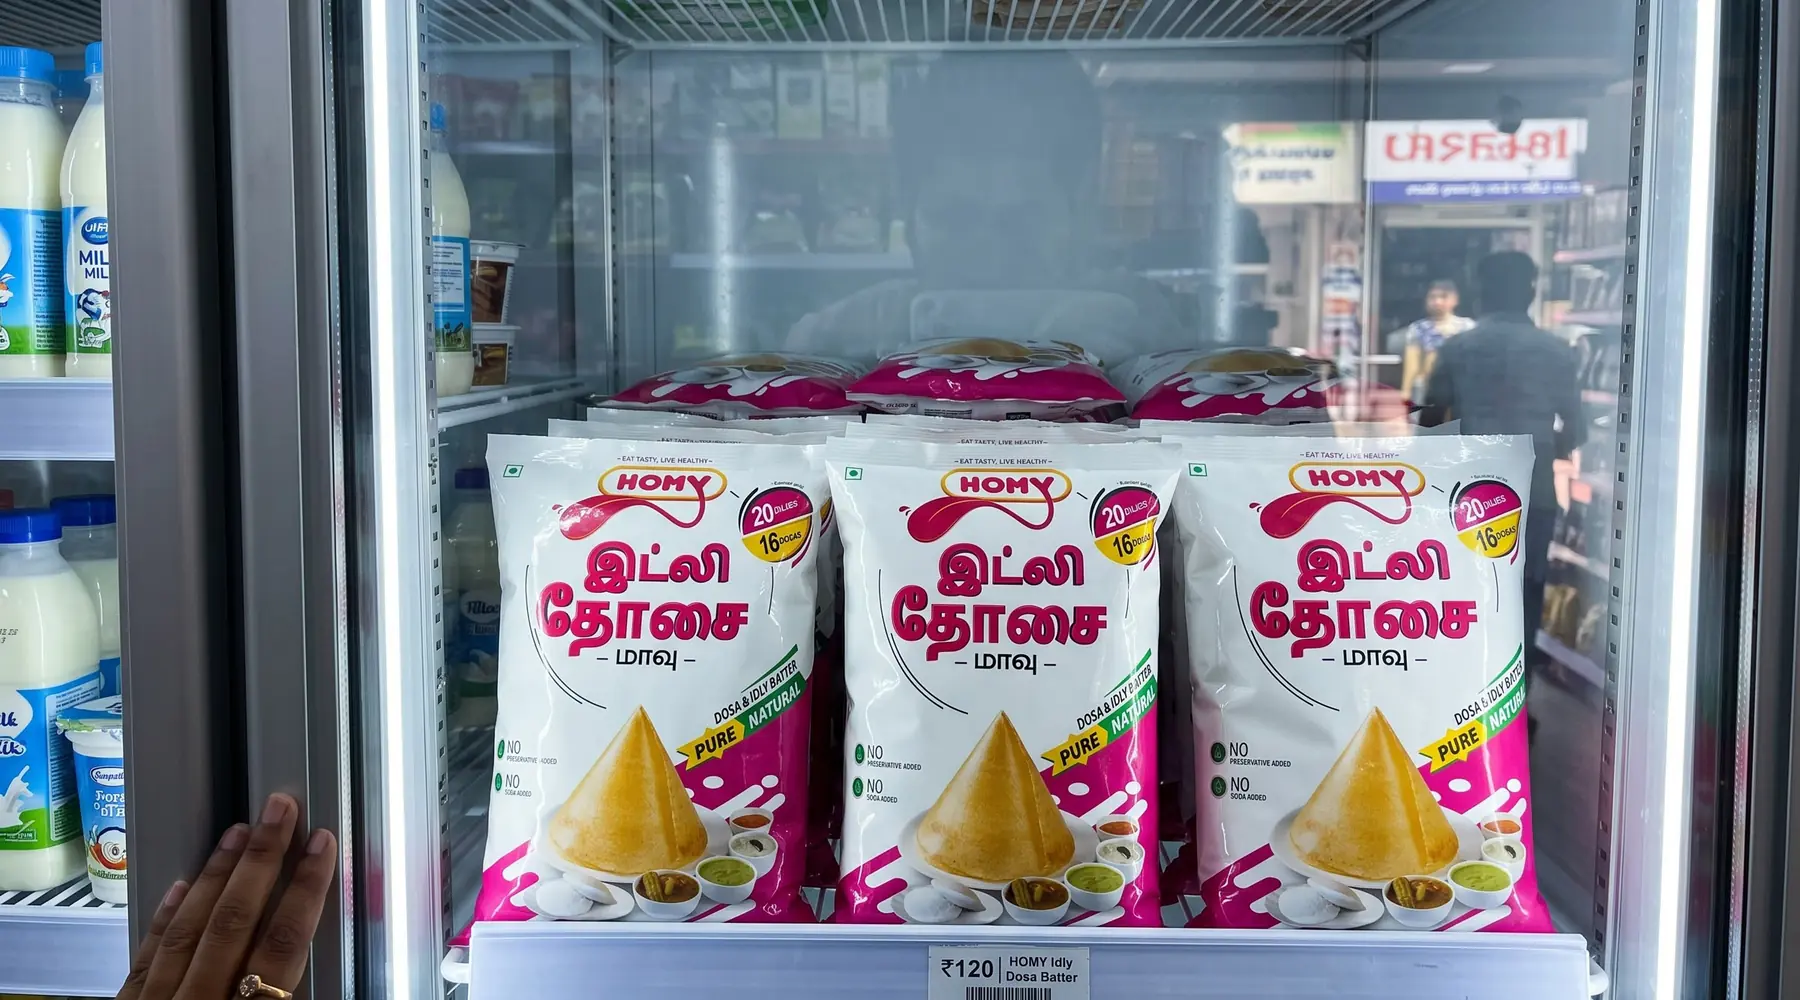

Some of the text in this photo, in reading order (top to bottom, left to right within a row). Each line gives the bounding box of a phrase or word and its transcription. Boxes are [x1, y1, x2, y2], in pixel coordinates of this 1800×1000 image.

[79, 250, 109, 266] MIL
[85, 267, 109, 279] MIL
[616, 474, 712, 493] HOMY
[960, 476, 1055, 495] HOMY
[1307, 469, 1406, 488] HOMY
[751, 503, 774, 527] 20
[1102, 504, 1126, 529] 20
[1460, 497, 1486, 523] 20
[759, 532, 780, 555] 16
[1113, 533, 1134, 558] 16
[1476, 527, 1498, 551] 16
[584, 540, 730, 594] இட்லி
[937, 543, 1084, 597] இட்லி
[1297, 538, 1450, 593] இட்லி
[537, 581, 749, 657] தோசை
[890, 584, 1107, 662] தோசை
[1249, 580, 1478, 658] தோசை
[616, 649, 677, 671] மாவு
[974, 653, 1037, 675] மாவு
[1343, 648, 1408, 671] மாவு
[714, 659, 798, 725] DOSA & IDLY BATTER
[1454, 701, 1482, 726] DOSA
[1487, 681, 1505, 704] IDLY
[1077, 706, 1104, 731] DOSA
[1104, 702, 1112, 714] &
[1110, 687, 1128, 709] IDLY
[694, 682, 801, 760] PURE NATURAL
[1059, 686, 1156, 766] PURE NATURAL
[507, 740, 521, 754] NO
[867, 745, 883, 759] NO
[1229, 742, 1248, 757] NO
[1438, 727, 1480, 762] PURE
[867, 760, 902, 769] PRESERVATIVE
[1229, 758, 1270, 767] PRESERVATIVE
[505, 774, 520, 789] NO
[867, 779, 883, 794] NO
[1231, 777, 1250, 792] NO
[881, 795, 898, 803] ADDED
[940, 956, 1073, 978] ₹120 HOMY Idly
[1006, 971, 1078, 983] Dosa Batter
